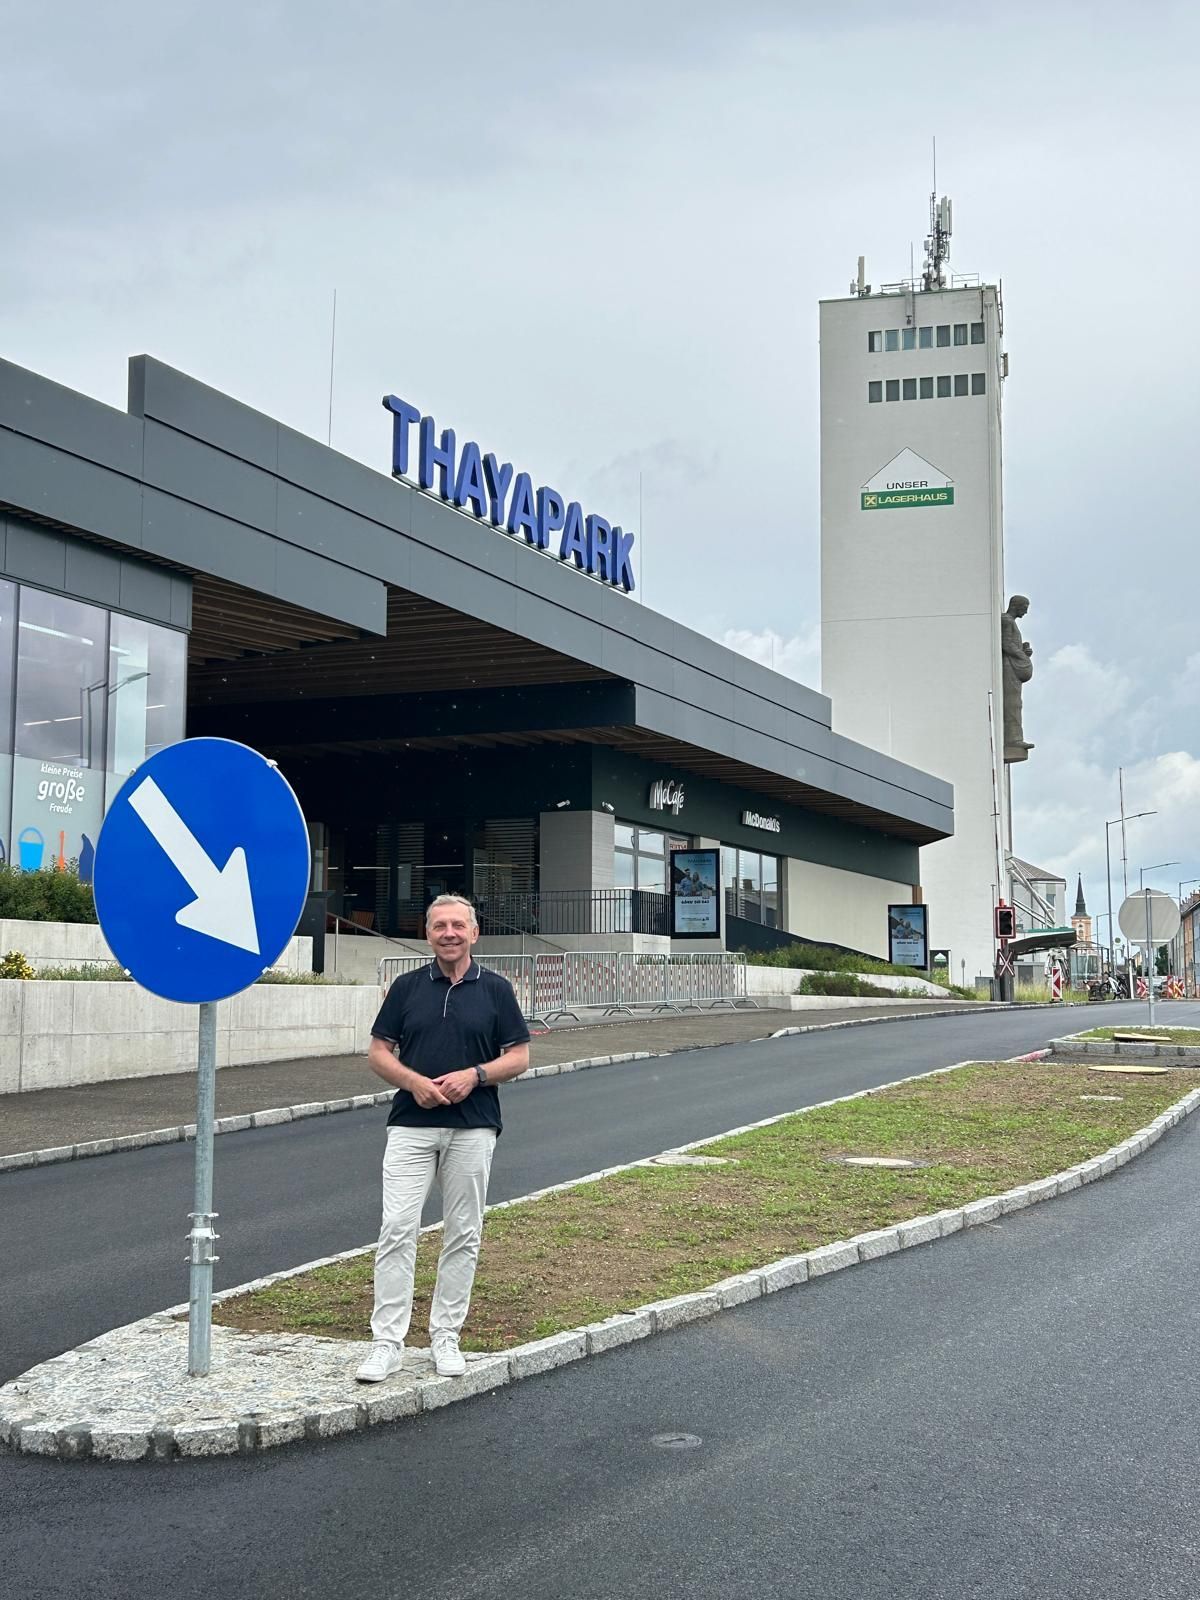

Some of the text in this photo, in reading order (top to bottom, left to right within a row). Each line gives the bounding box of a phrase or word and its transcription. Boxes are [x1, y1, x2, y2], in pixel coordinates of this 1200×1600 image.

[886, 481, 928, 490] UNSER
[382, 394, 635, 593] THAYAPARK
[878, 493, 947, 504] LAGERHAUS
[40, 763, 83, 779] kleine Preise
[37, 779, 85, 804] große
[49, 803, 73, 814] Freude
